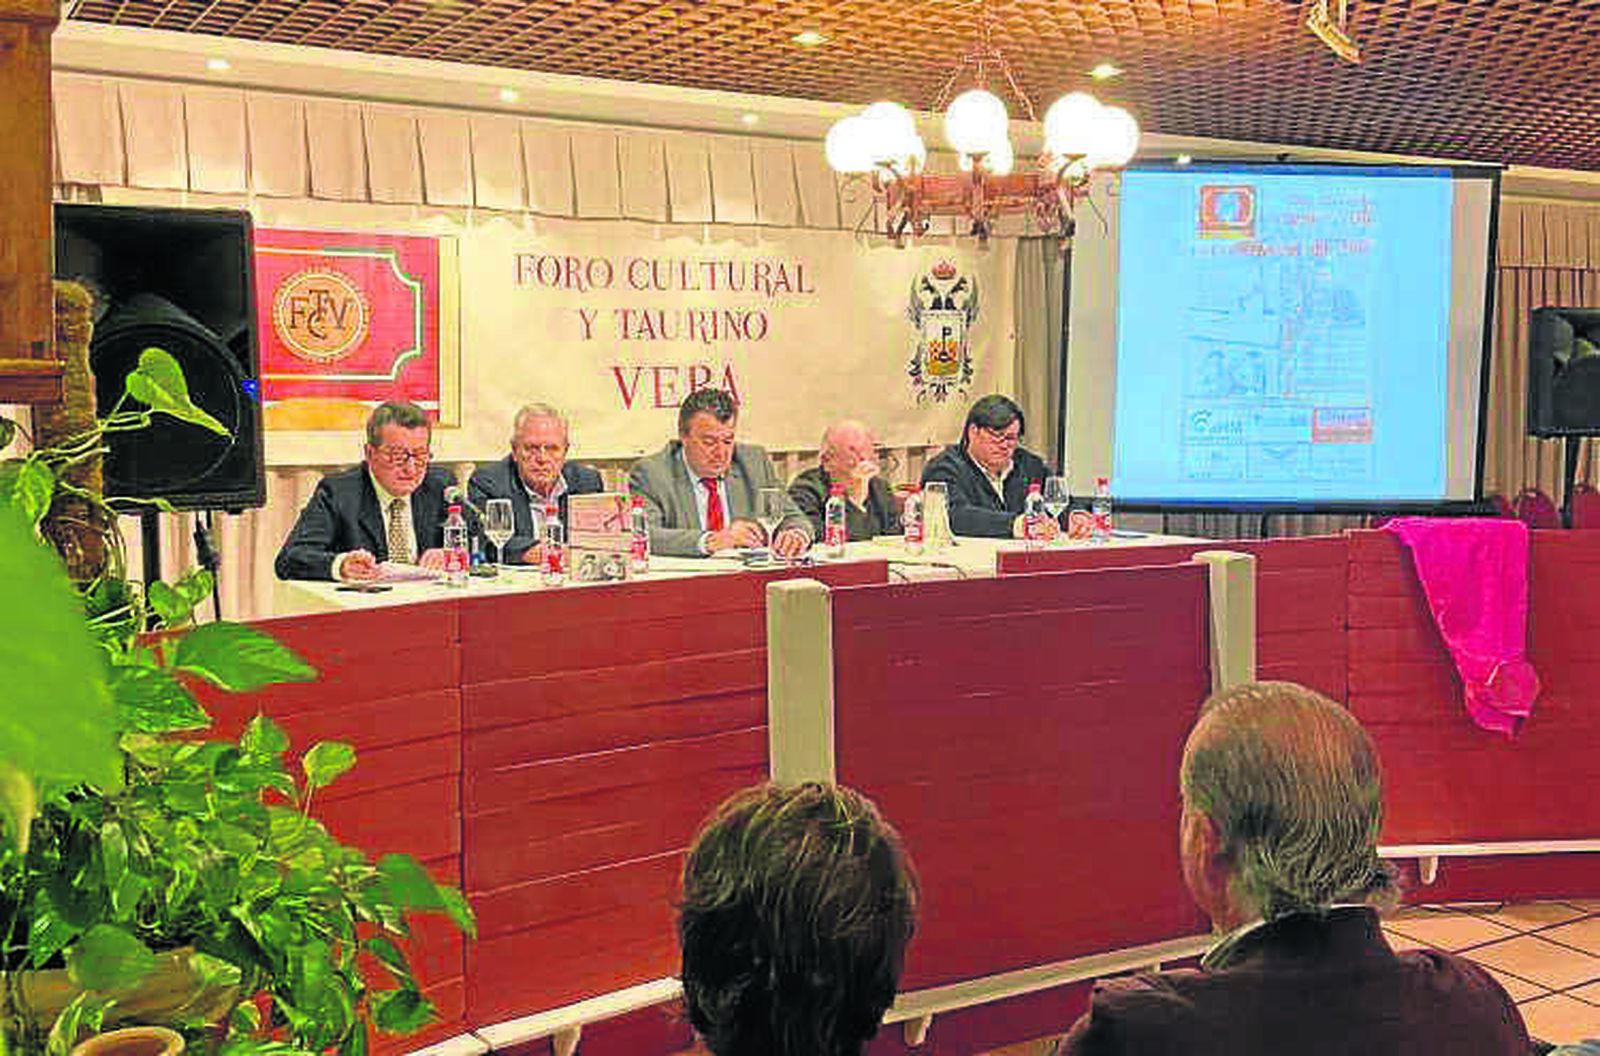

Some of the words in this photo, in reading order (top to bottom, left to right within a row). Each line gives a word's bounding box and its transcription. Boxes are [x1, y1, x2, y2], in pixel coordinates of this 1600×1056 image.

[514, 254, 614, 293] FORO
[627, 256, 816, 297] CULTURAL
[578, 308, 598, 341] Y
[614, 308, 769, 344] TAURINO
